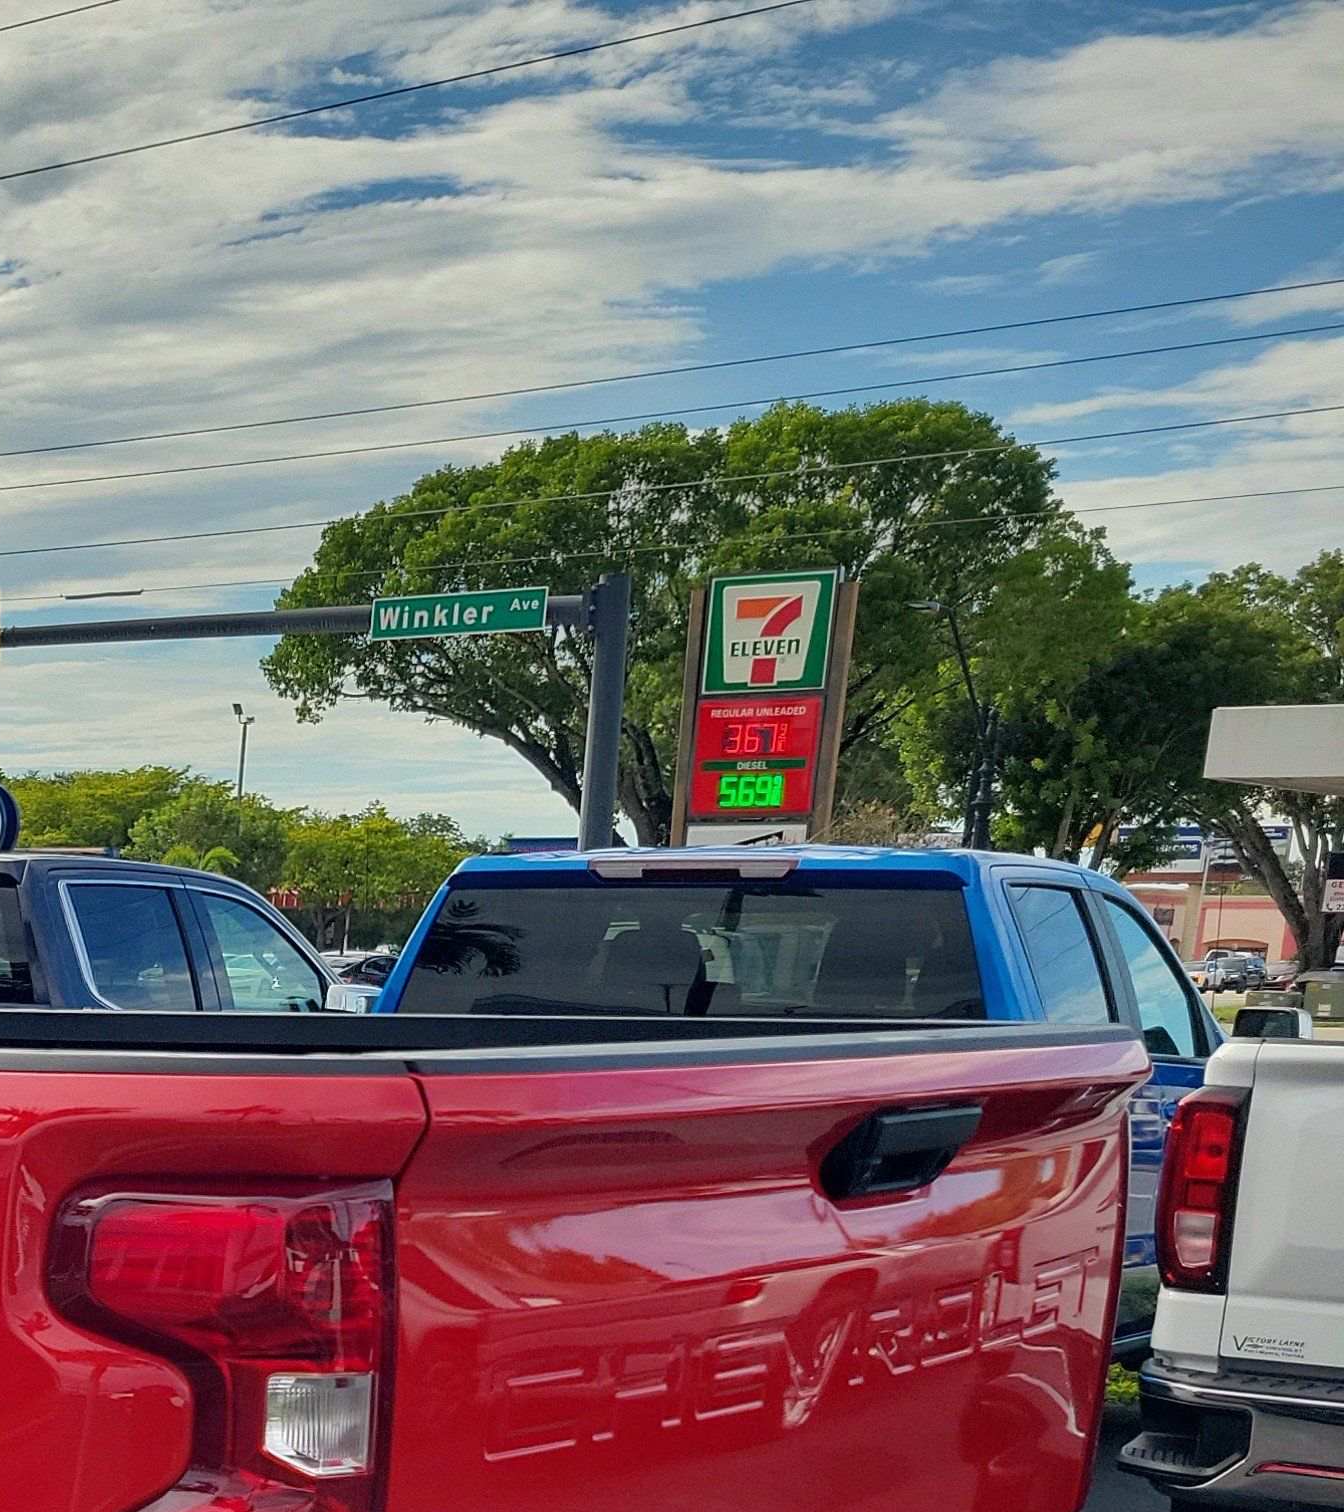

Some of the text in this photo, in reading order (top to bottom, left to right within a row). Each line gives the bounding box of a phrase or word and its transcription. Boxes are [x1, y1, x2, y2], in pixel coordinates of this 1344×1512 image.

[379, 598, 539, 630] Winkler Ave
[736, 595, 803, 684] 7
[711, 705, 806, 718] REGULAR UNLEADED
[736, 760, 768, 771] DIESEL
[1233, 1335, 1305, 1351] VICTORY LAYNE
